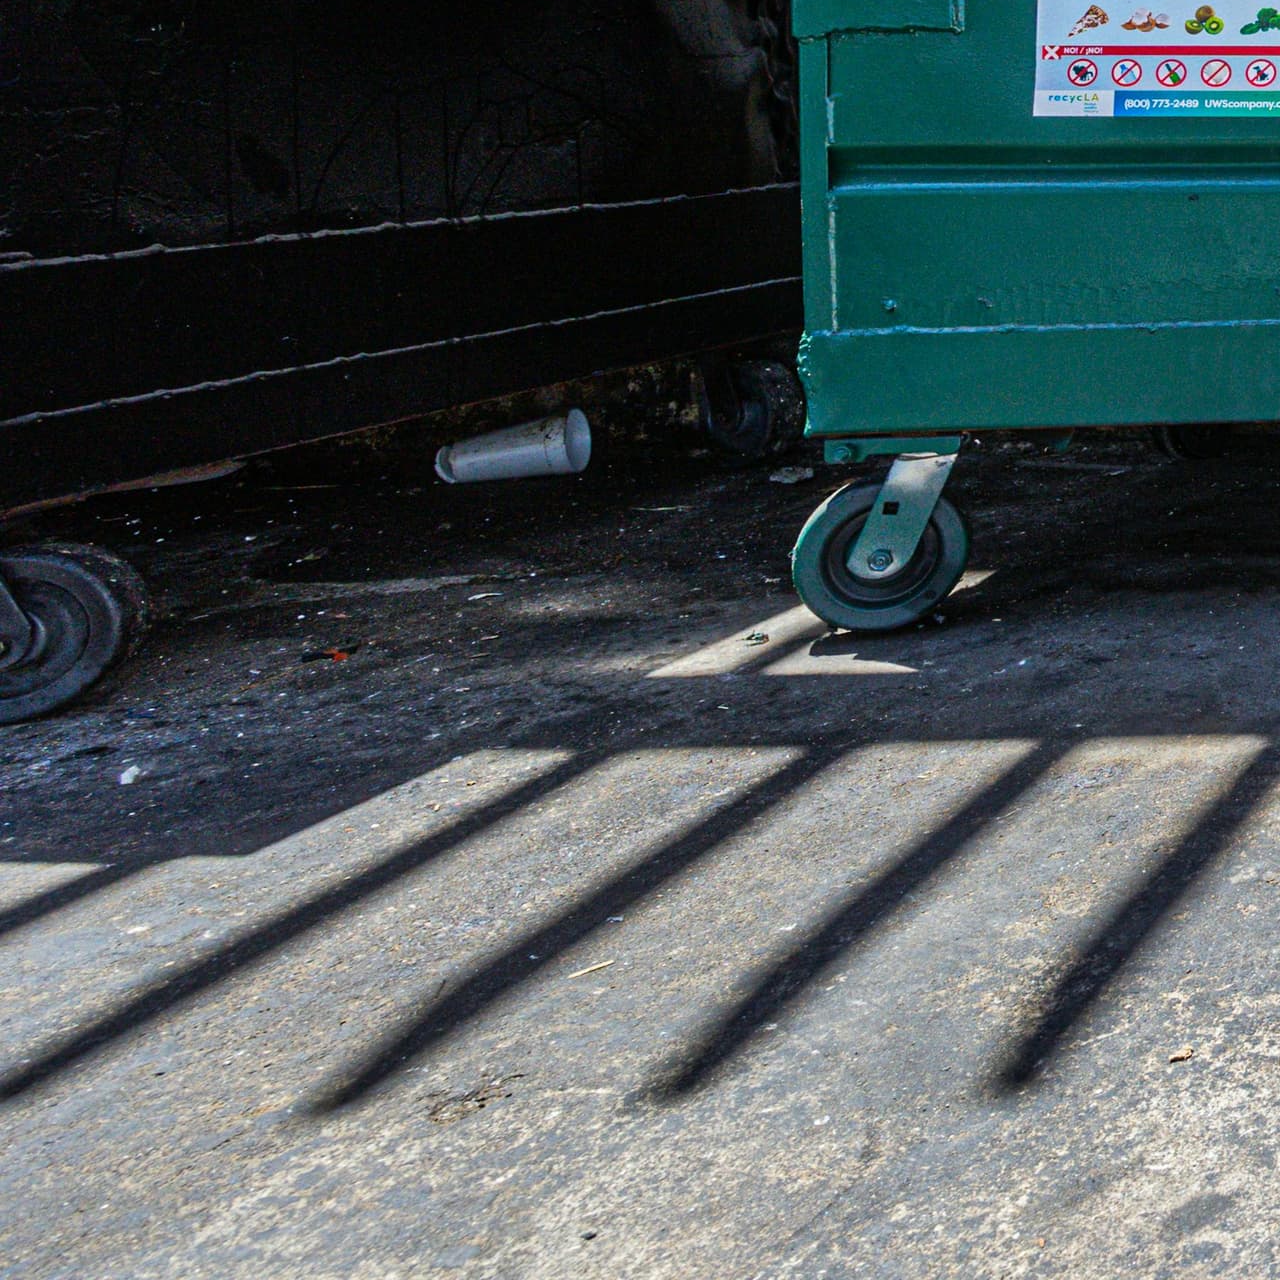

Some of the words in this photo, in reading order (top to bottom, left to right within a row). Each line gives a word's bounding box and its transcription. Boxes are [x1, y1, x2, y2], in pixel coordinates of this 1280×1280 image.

[1063, 46, 1079, 54] NO!
[1048, 93, 1100, 104] recycLA
[1124, 98, 1150, 110] (800)
[1152, 98, 1199, 109] 773-2489
